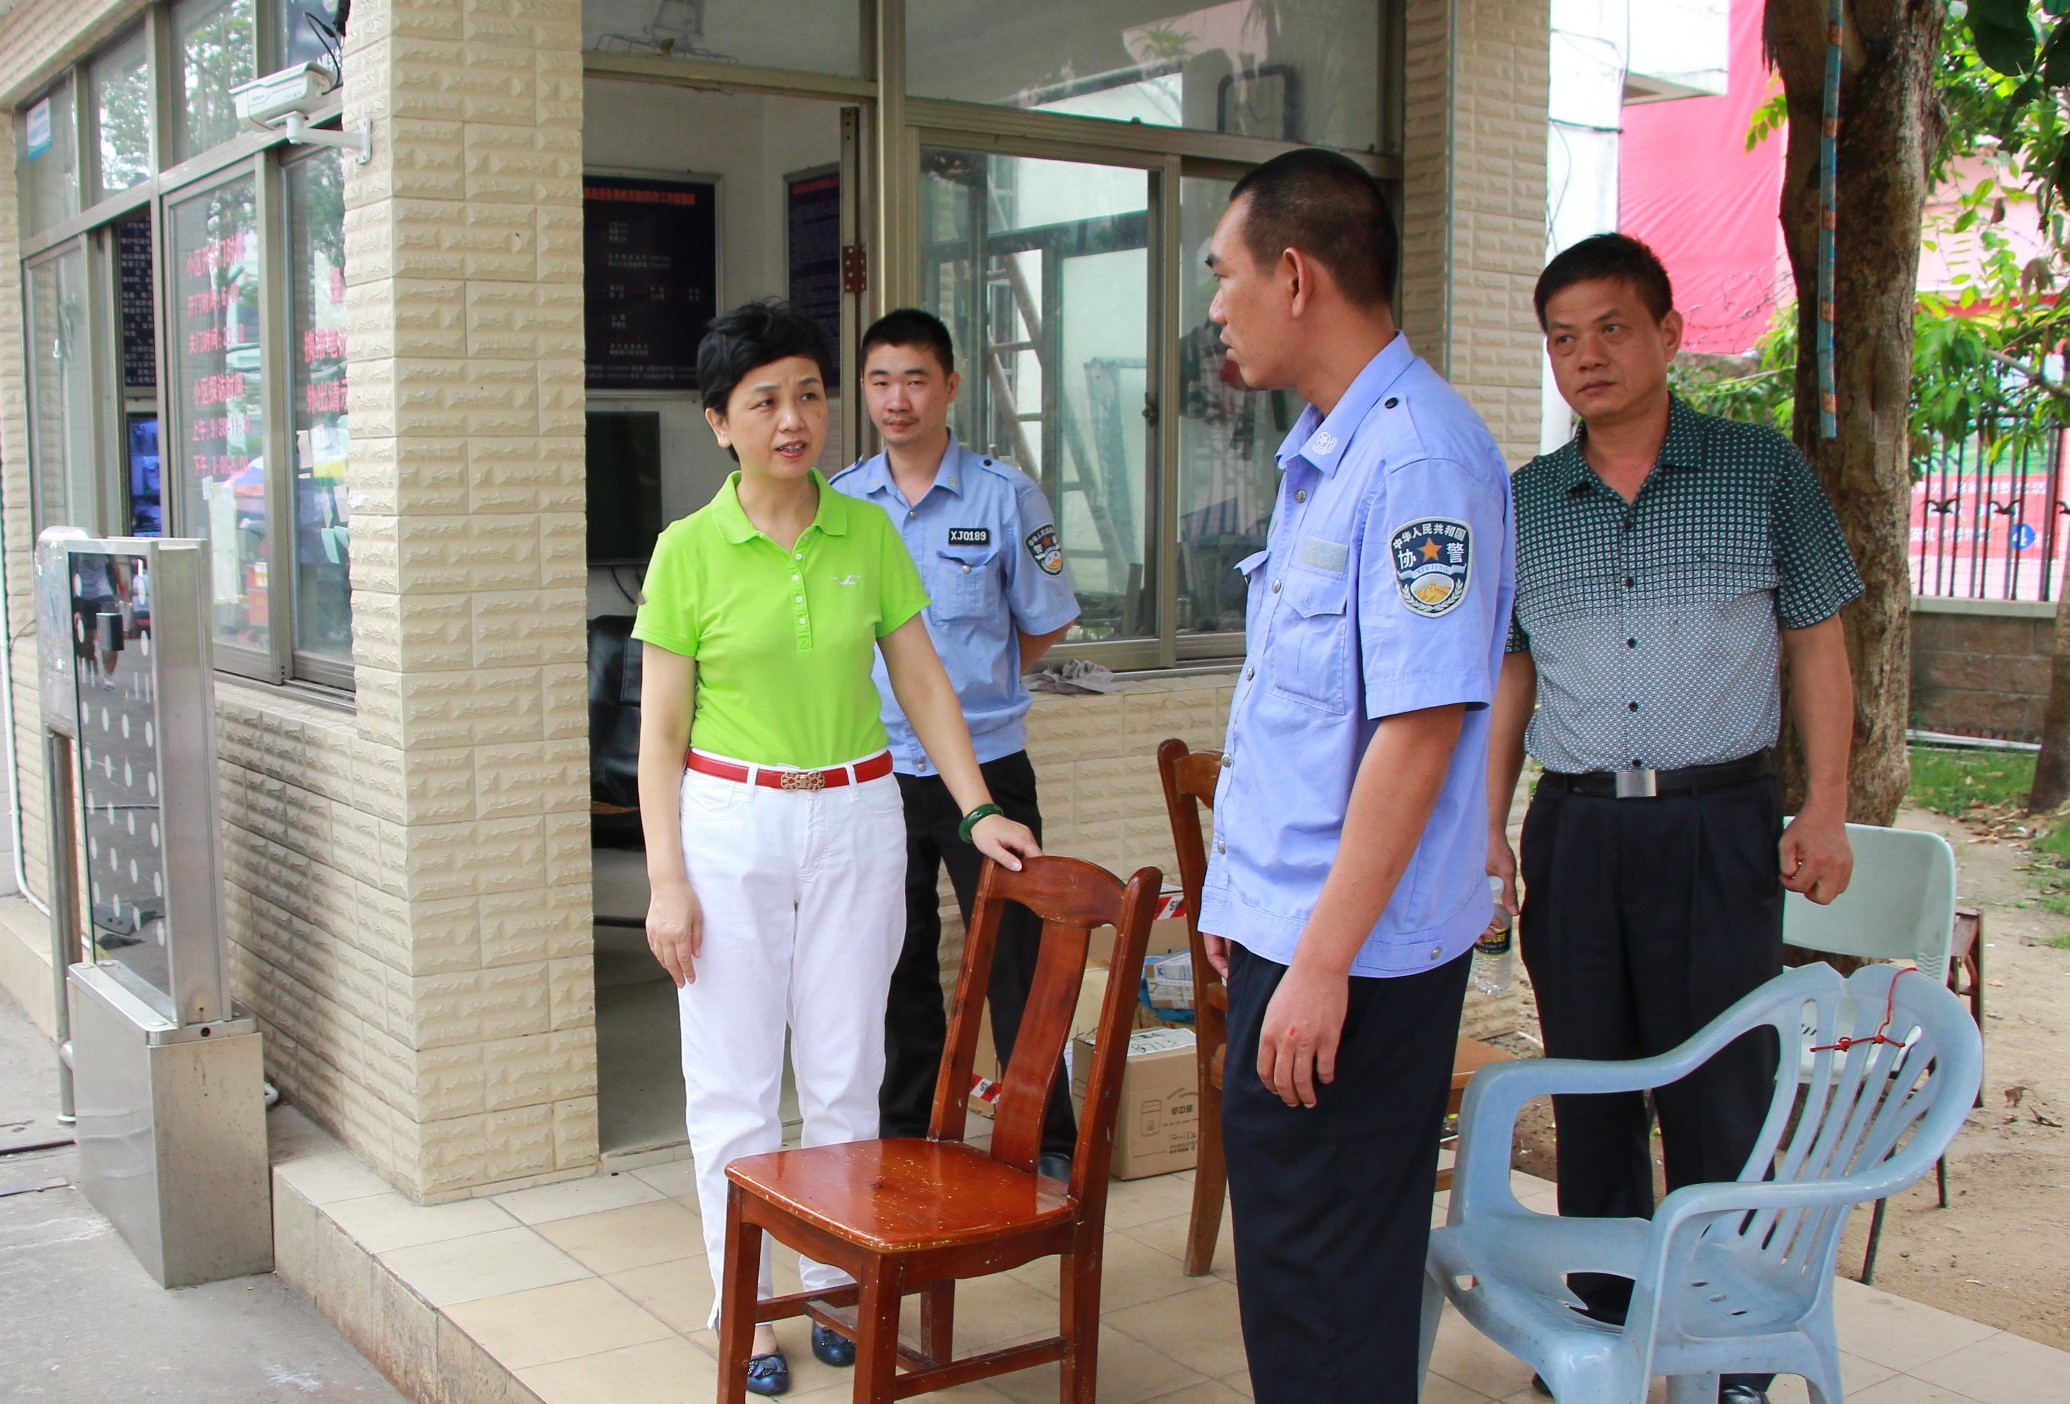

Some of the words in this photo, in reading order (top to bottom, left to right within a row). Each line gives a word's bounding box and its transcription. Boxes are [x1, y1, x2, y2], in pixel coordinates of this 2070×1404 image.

[950, 530, 987, 541] XJ0189
[1392, 523, 1467, 549] 中华人民共和国
